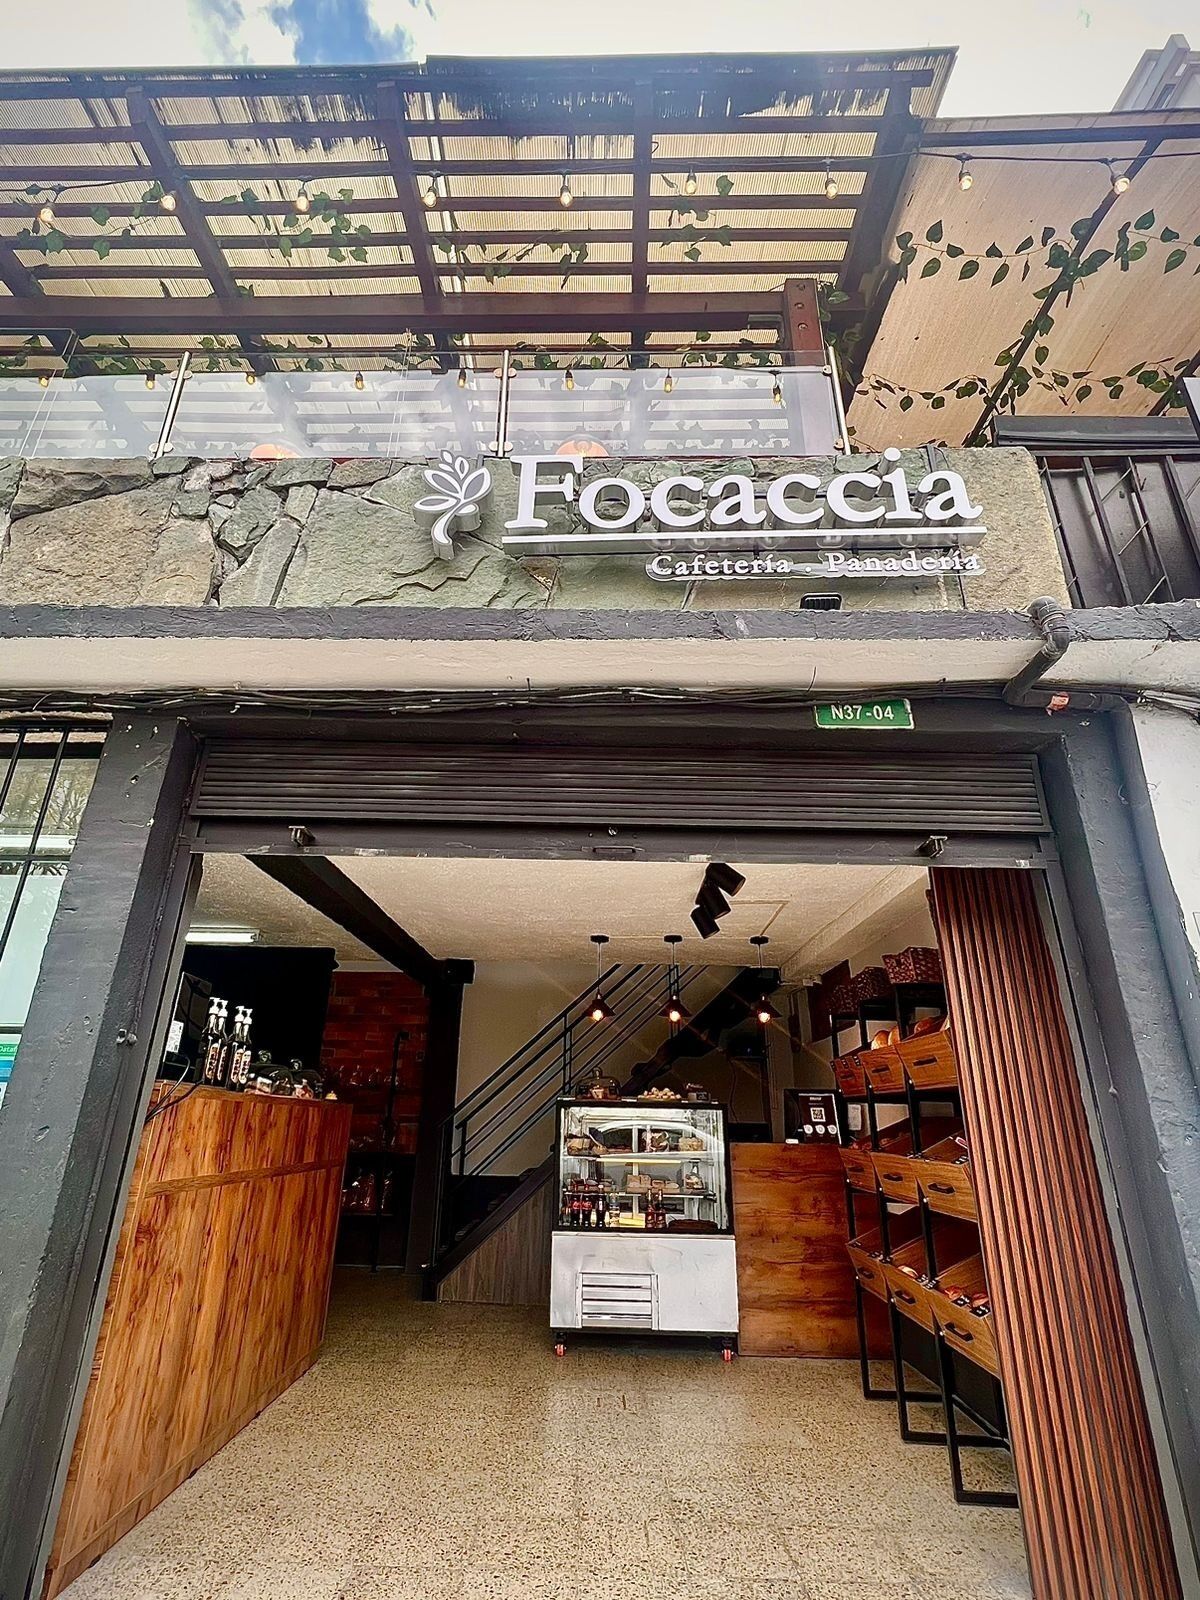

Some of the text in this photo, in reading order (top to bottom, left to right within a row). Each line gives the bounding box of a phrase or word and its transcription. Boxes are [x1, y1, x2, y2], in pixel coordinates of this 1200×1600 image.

[504, 448, 984, 529] Focaccia
[651, 553, 790, 577] Cafetería
[826, 551, 981, 573] Panadería
[831, 704, 895, 720] N37-04
